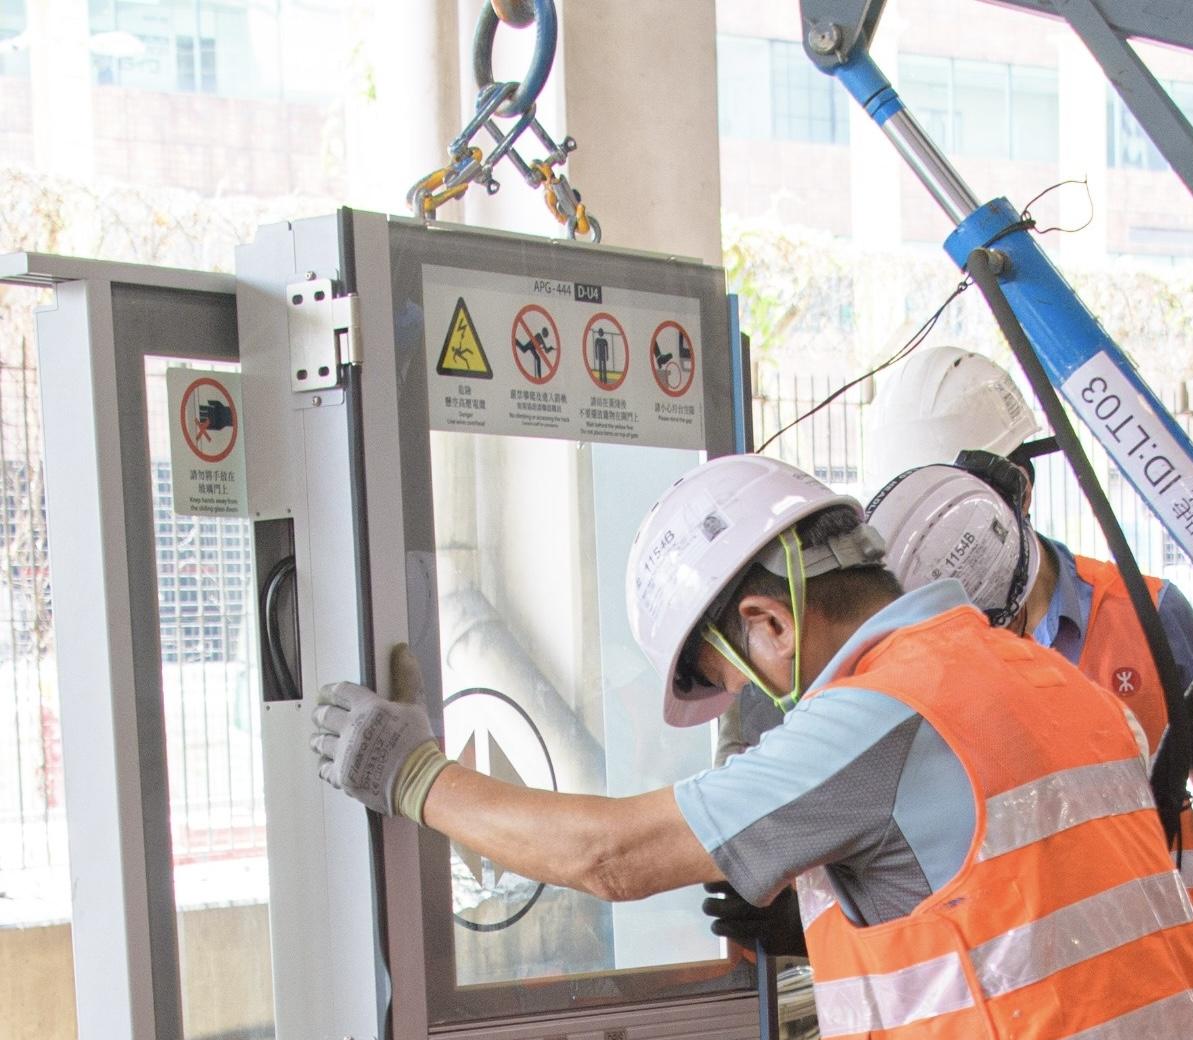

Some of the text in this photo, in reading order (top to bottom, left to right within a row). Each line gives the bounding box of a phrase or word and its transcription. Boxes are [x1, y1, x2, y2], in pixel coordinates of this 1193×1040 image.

[534, 281, 599, 300] APG-444 D-U4
[944, 531, 976, 569] 1154B
